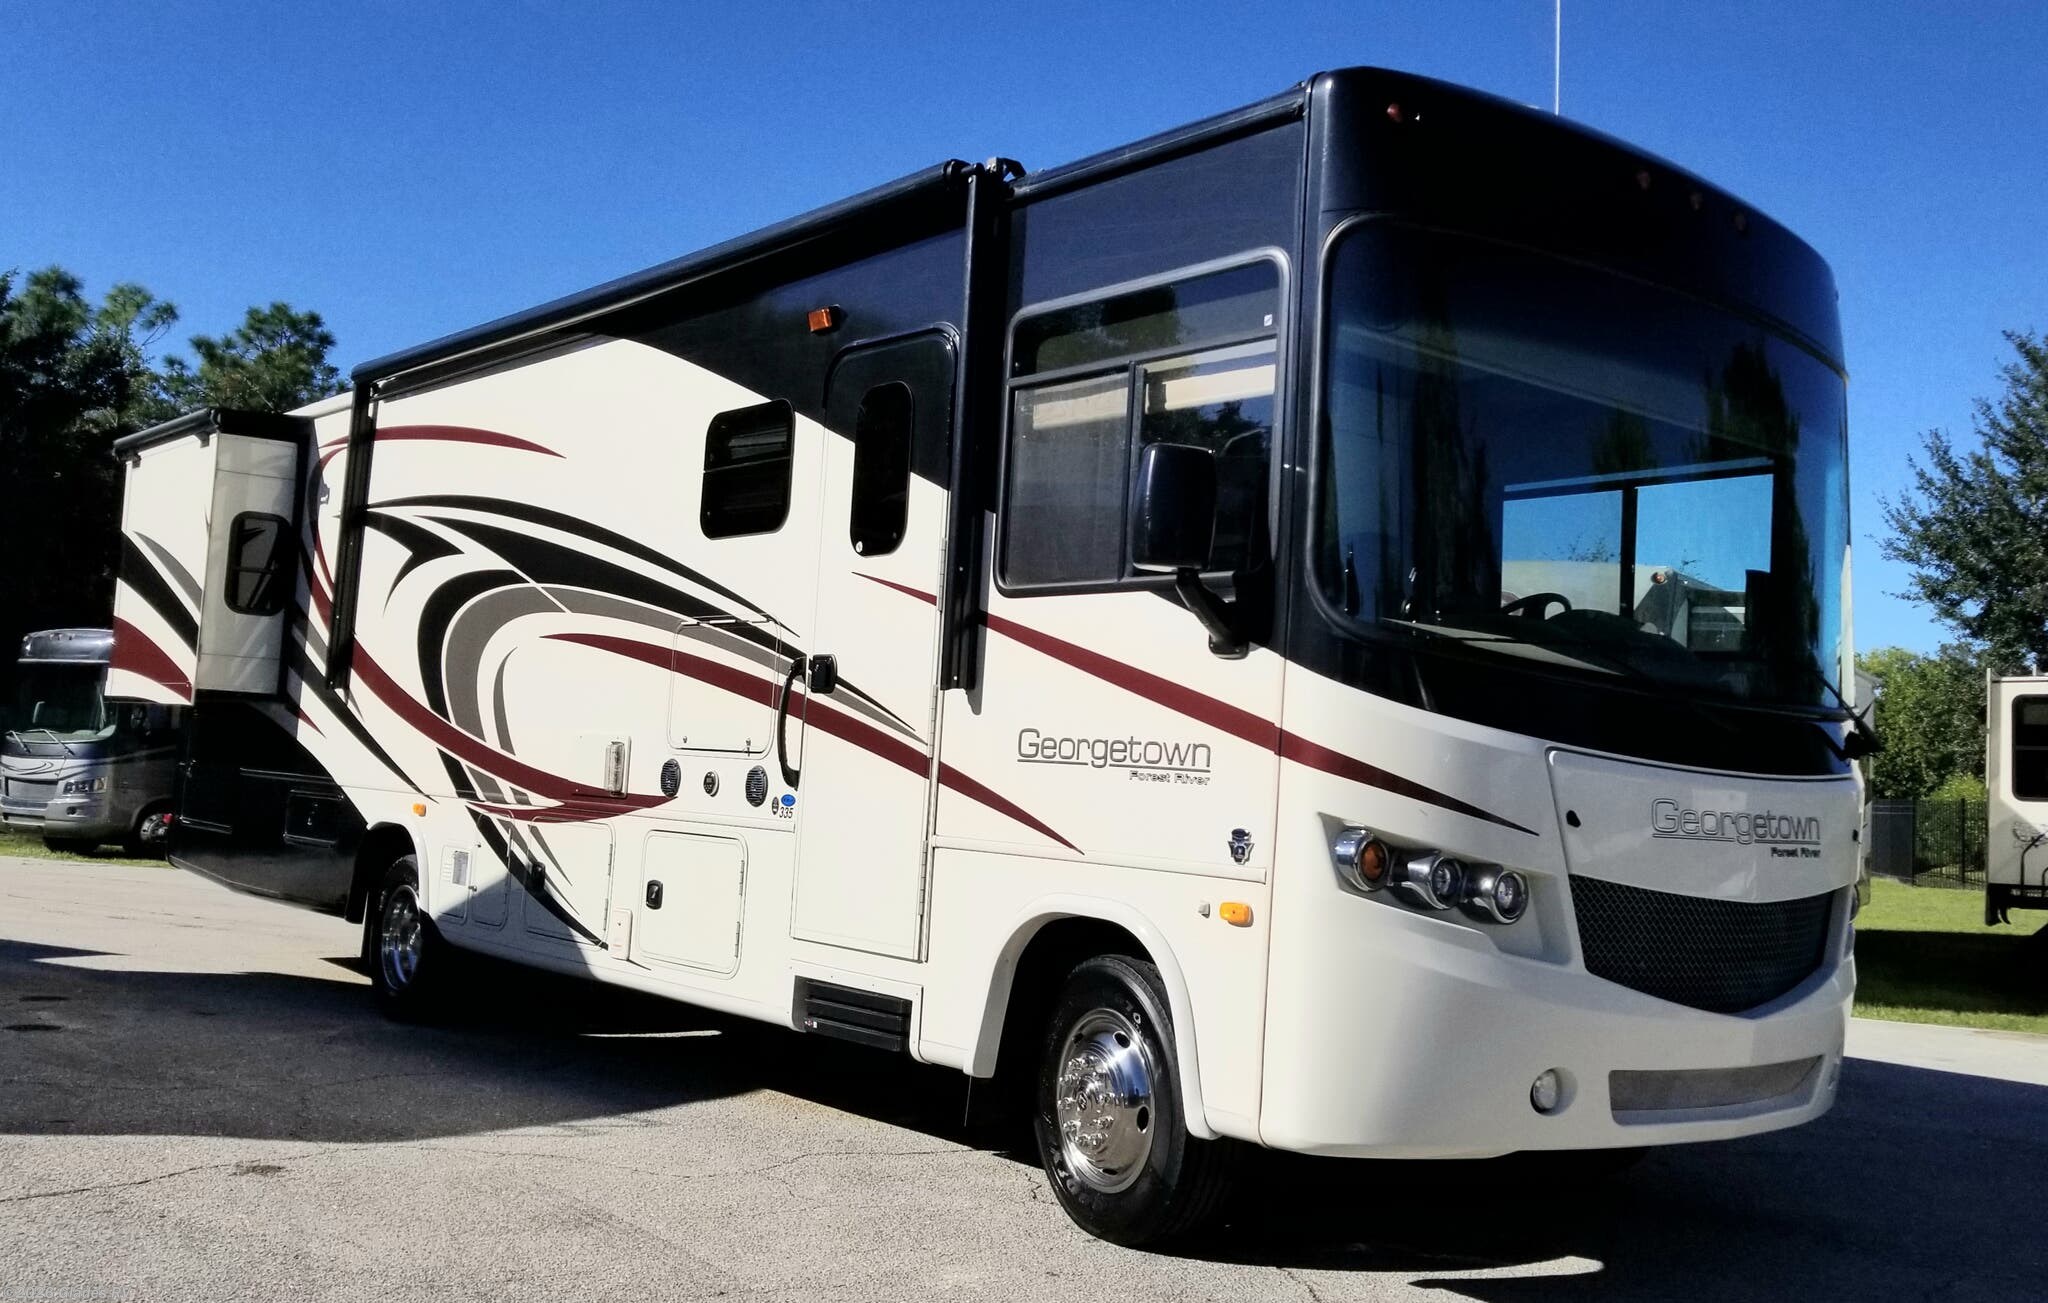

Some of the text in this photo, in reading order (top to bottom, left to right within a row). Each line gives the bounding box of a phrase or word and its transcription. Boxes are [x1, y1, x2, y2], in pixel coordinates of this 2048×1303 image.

[1018, 727, 1212, 769] Georgetown
[1129, 770, 1211, 786] Forest River
[779, 806, 794, 819] 335
[1651, 797, 1821, 845] Georgetown
